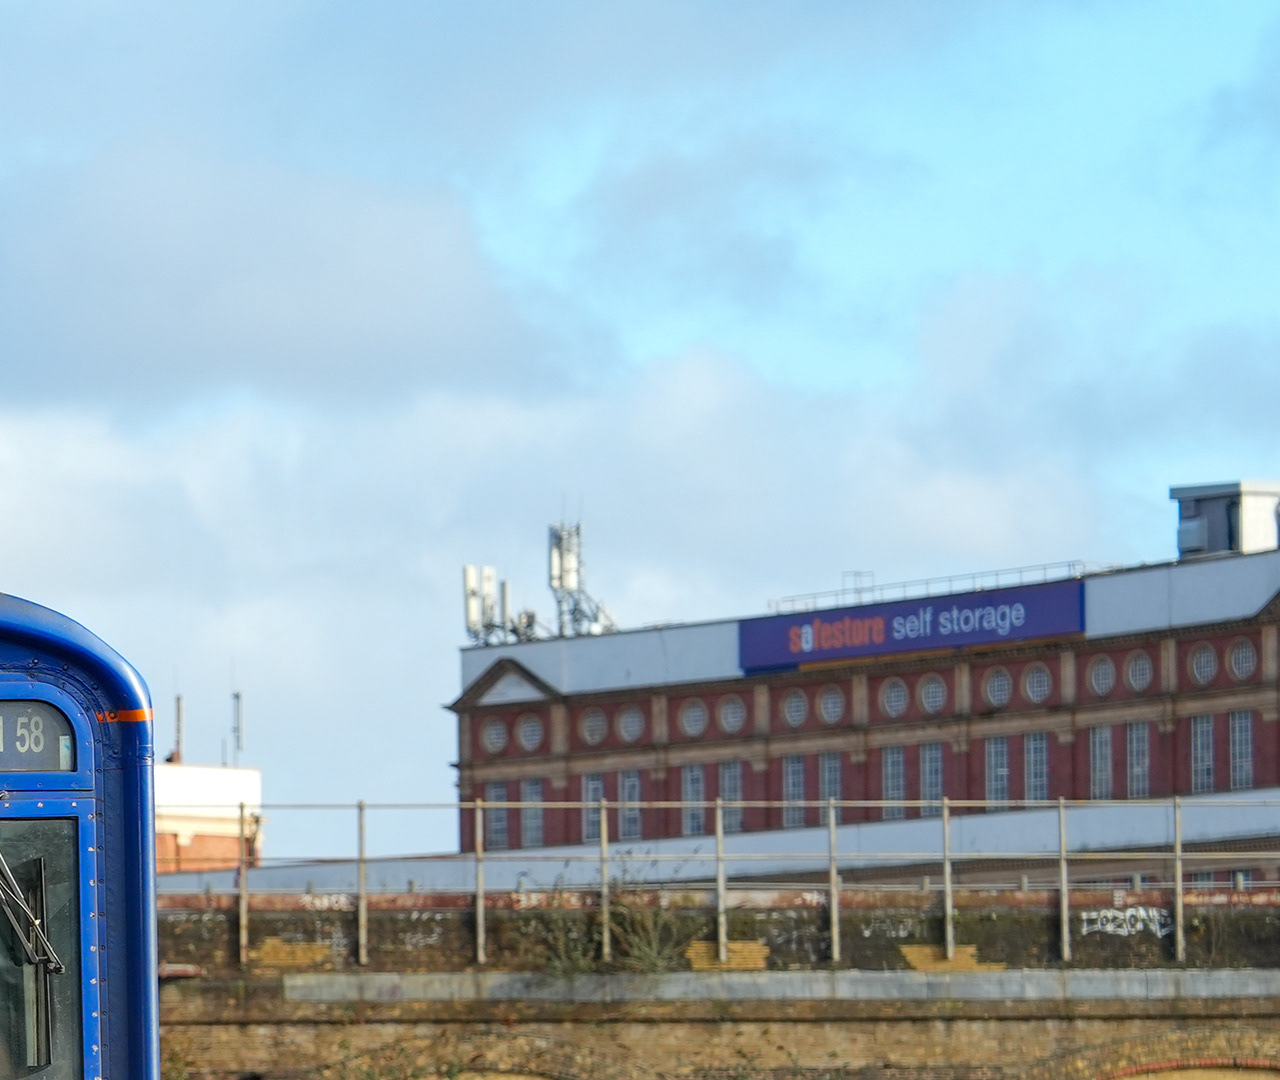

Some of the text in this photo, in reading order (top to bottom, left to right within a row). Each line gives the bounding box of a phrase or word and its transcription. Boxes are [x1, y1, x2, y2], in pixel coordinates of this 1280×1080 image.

[788, 602, 1026, 653] safestore self storage
[15, 716, 45, 752] 58
